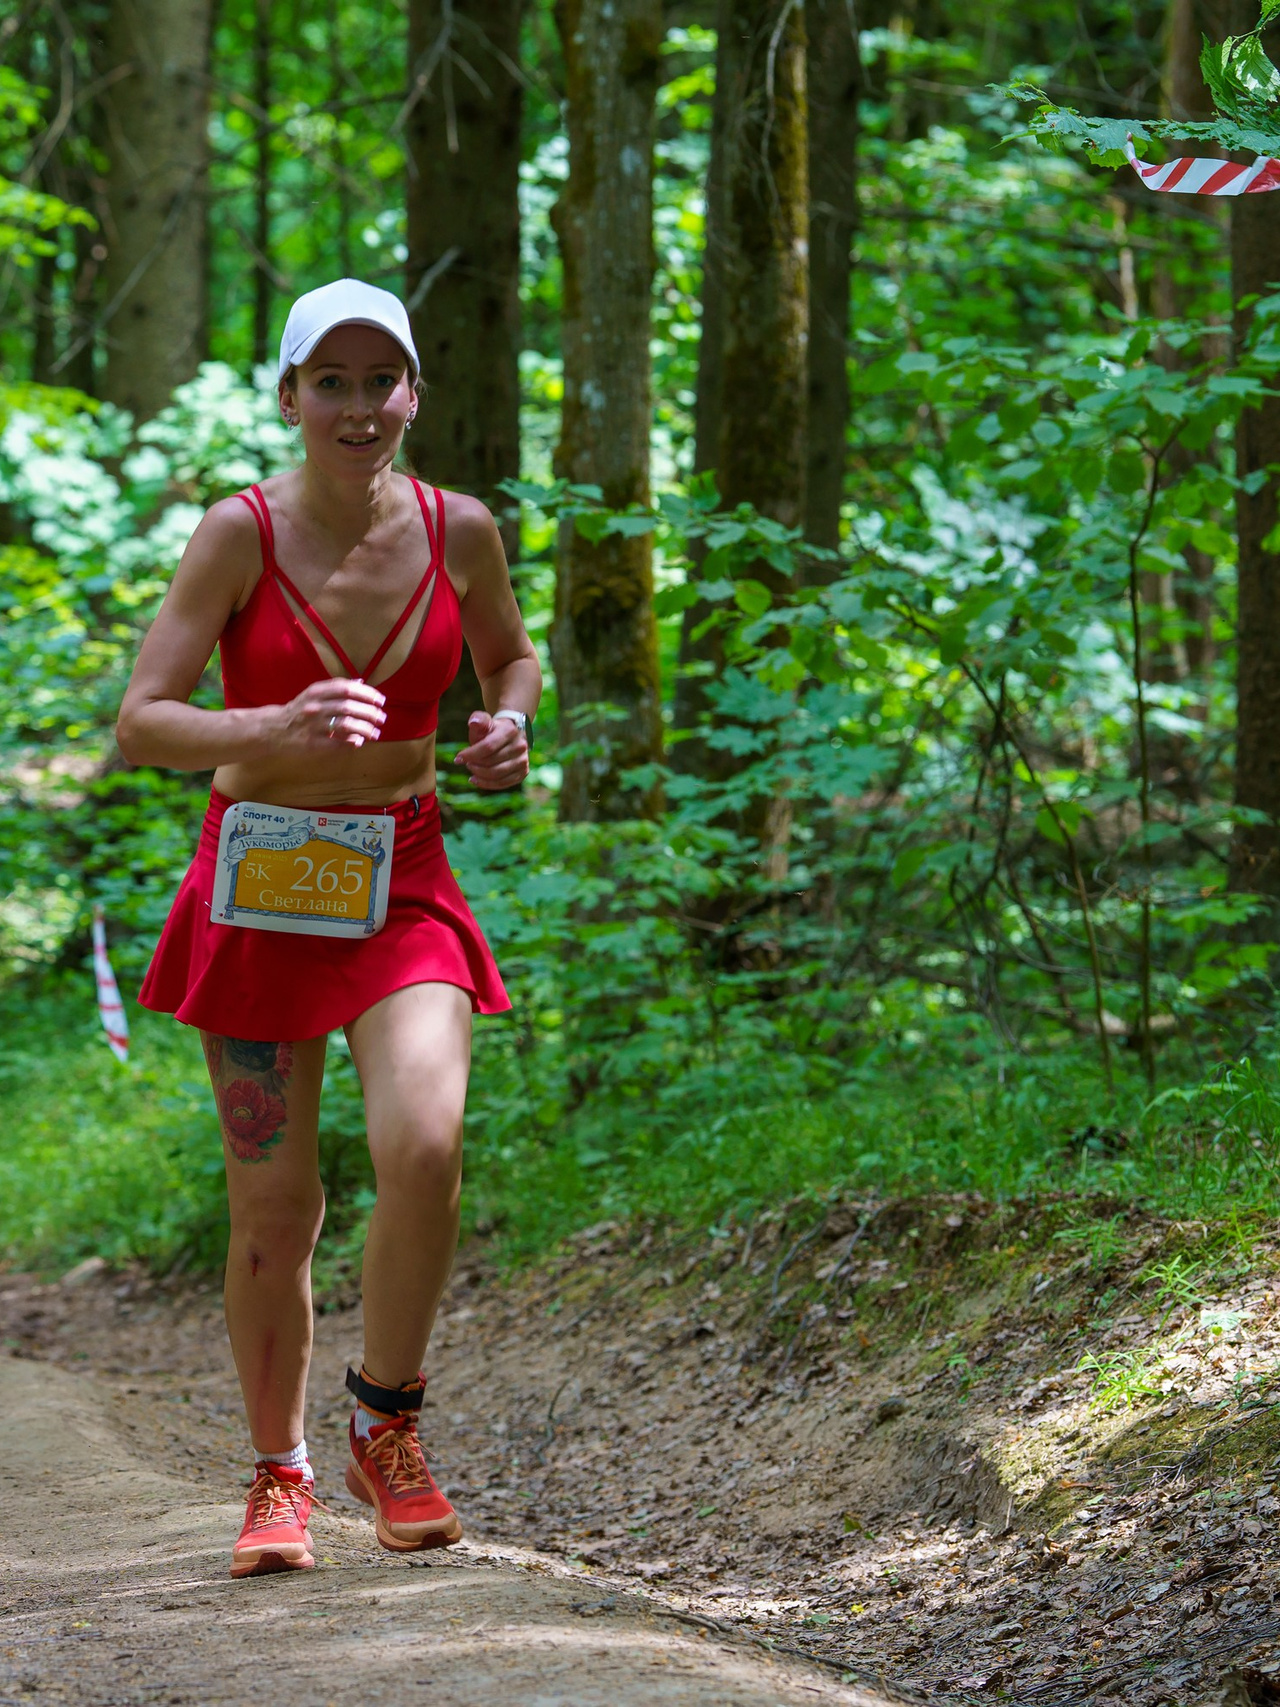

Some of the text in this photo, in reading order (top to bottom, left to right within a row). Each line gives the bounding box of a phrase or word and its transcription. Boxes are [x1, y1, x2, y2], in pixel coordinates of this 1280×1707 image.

[242, 810, 285, 824] СПОРТ 40
[237, 837, 302, 851] Лукоморье
[289, 856, 363, 895] 265
[258, 889, 348, 914] Светлана
